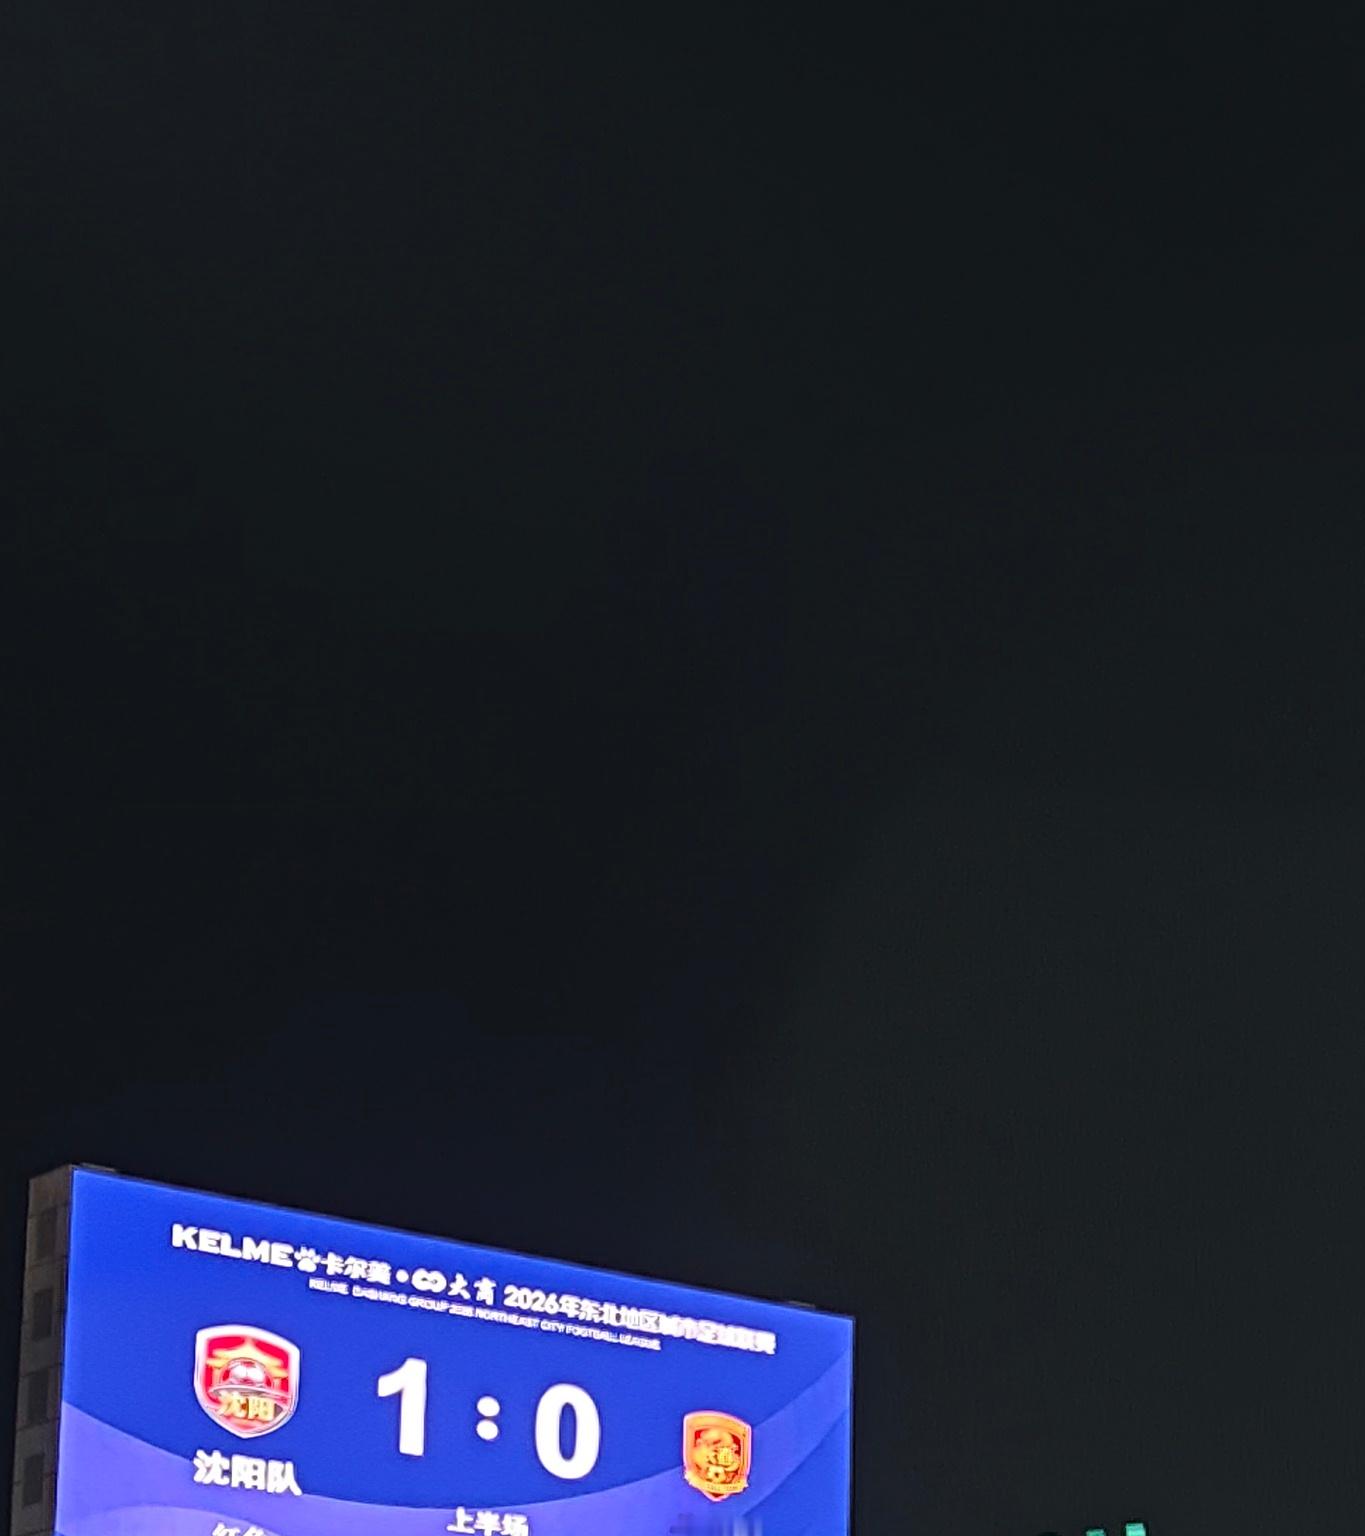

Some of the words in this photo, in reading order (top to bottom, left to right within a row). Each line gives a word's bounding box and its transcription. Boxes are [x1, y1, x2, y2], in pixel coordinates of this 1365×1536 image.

[172, 1224, 294, 1267] KELME
[321, 1251, 391, 1285] 卡尔美
[378, 1357, 428, 1457] 1
[534, 1383, 601, 1480] 0
[193, 1449, 302, 1496] 沈阳队
